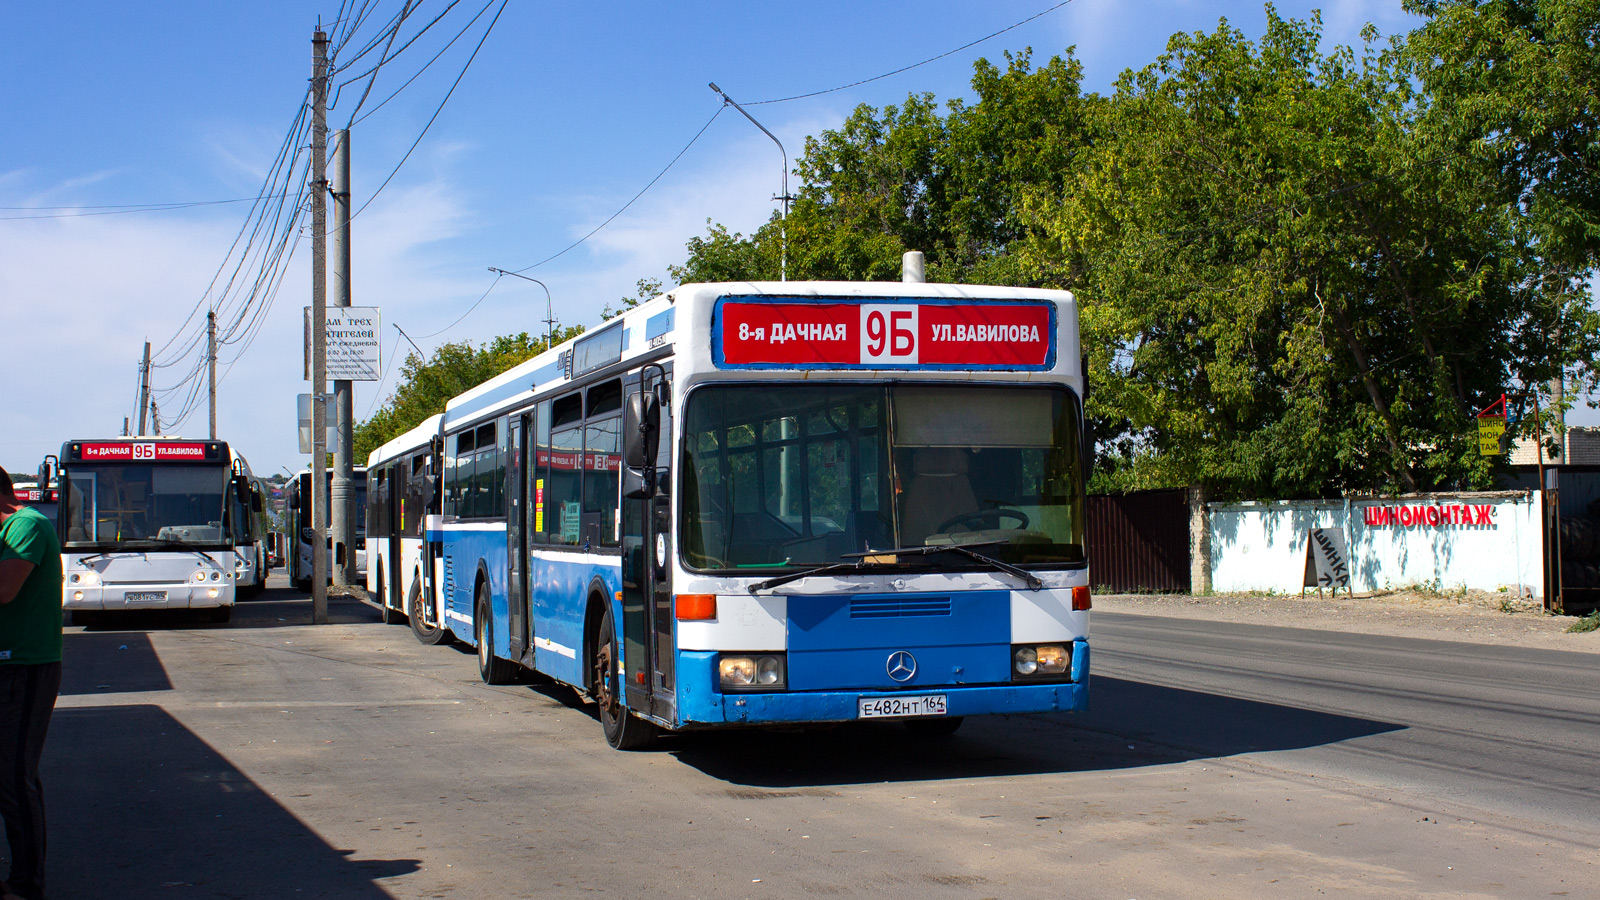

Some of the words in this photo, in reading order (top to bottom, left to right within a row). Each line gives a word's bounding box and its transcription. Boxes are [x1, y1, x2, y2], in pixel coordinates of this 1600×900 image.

[348, 318, 372, 326] ТРЕХ
[739, 323, 764, 341] 8-я
[769, 323, 847, 344] ДАЧНАЯ
[866, 310, 915, 357] 9Б
[931, 323, 1040, 343] УЛ.ВАВИЛОВА
[1479, 419, 1504, 428] ШИНО
[87, 447, 98, 455] 8-я
[99, 447, 130, 456] ДАЧНАЯ
[135, 445, 153, 458] 9Б
[157, 447, 203, 455] УЛ.ВАВИЛОВА
[1480, 443, 1499, 451] ТАЖ
[1363, 504, 1494, 527] ШИНОМОНТАЖ
[1313, 528, 1350, 587] ШИНКА
[864, 699, 919, 716] Е482НТ
[922, 696, 944, 709] 164
